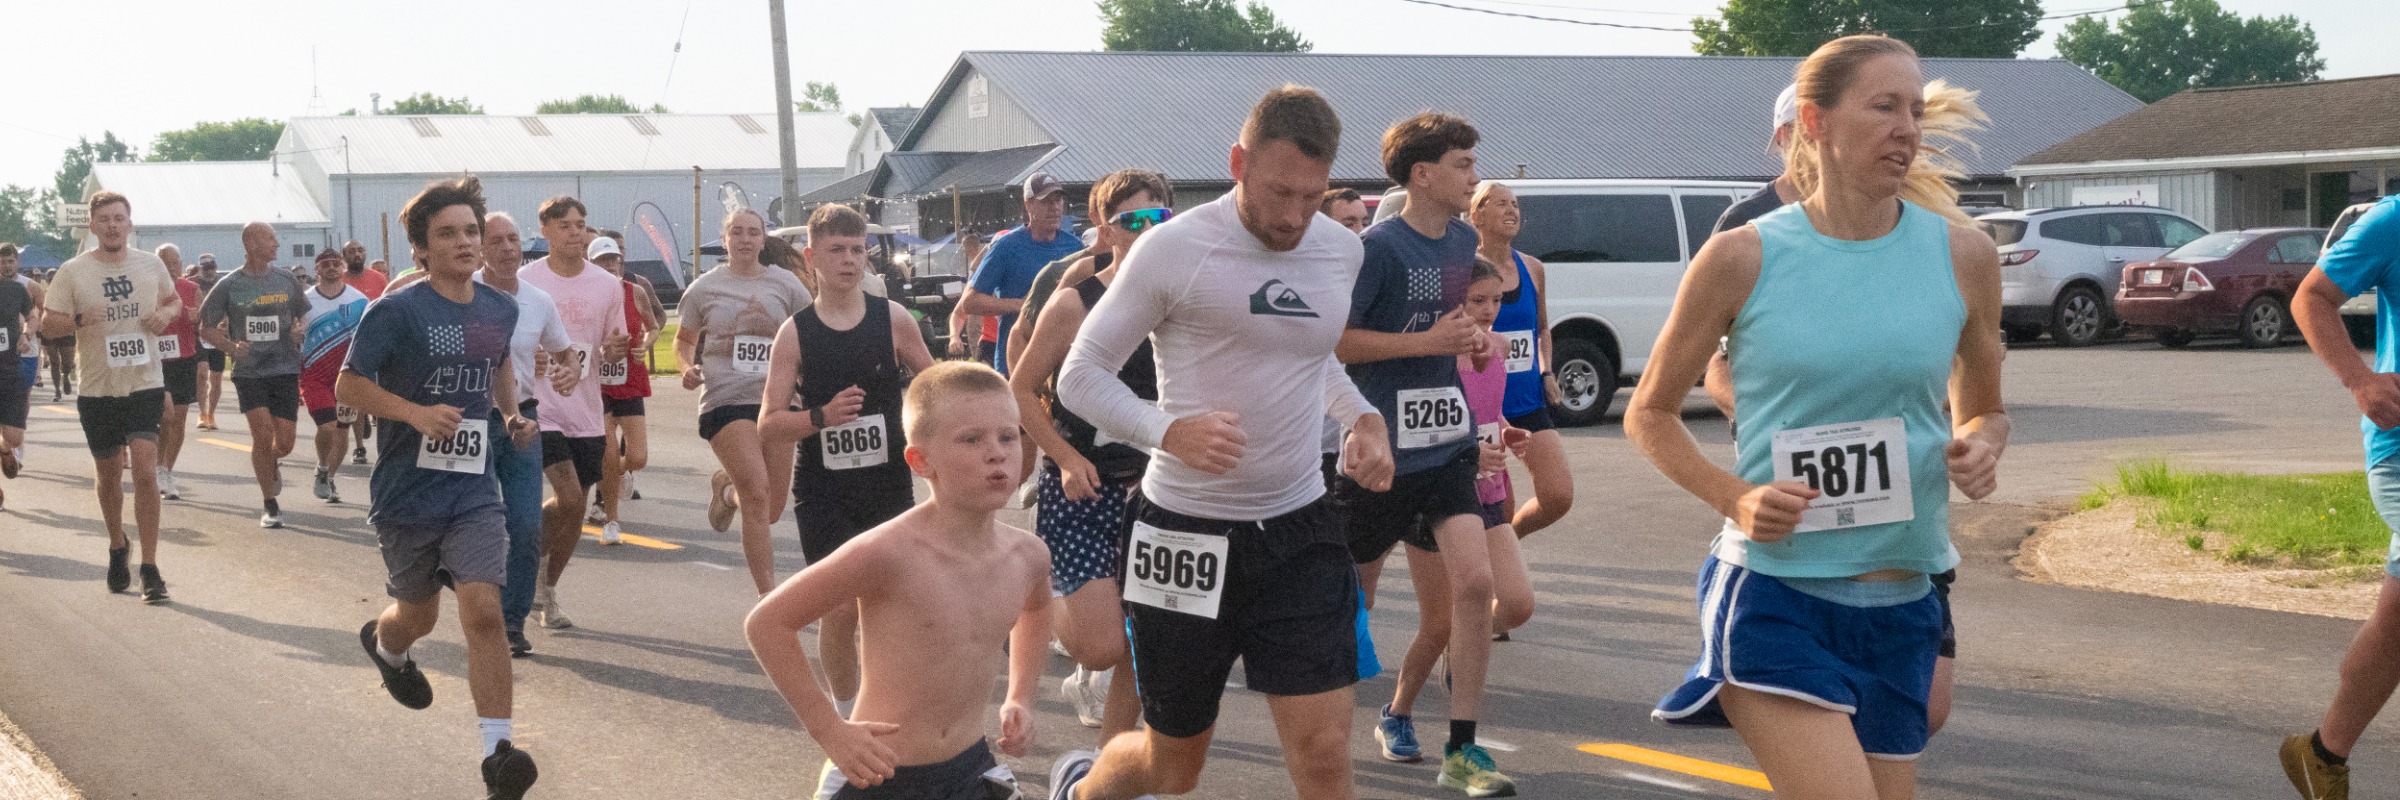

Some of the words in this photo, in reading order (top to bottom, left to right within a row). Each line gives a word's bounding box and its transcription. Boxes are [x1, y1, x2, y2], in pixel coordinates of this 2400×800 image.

[107, 302, 139, 321] RISH
[249, 321, 276, 334] 5900
[109, 339, 145, 358] 5938
[158, 340, 176, 352] 851
[1507, 338, 1530, 359] 92
[599, 363, 625, 377] 905
[1404, 397, 1463, 430] 5265
[426, 430, 481, 457] 5893
[825, 425, 882, 455] 5868
[1791, 440, 1891, 497] 5871
[1134, 539, 1218, 592] 5969
